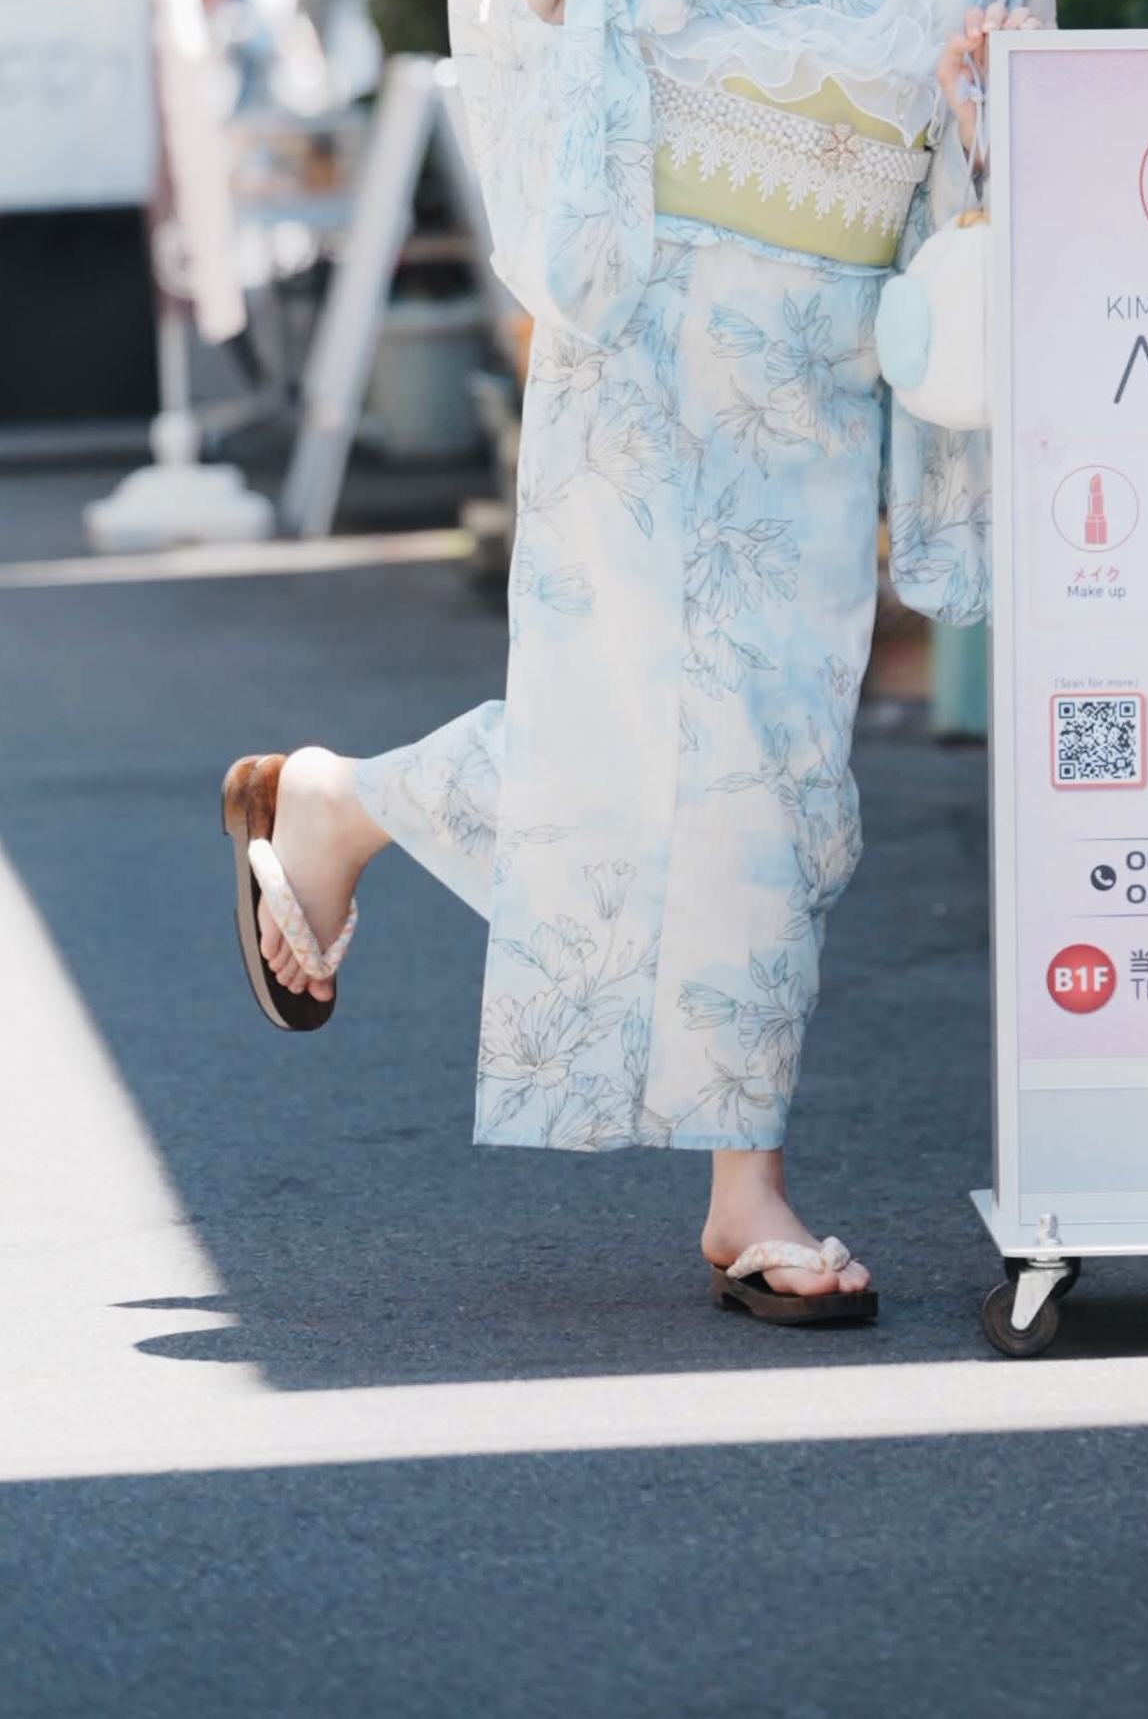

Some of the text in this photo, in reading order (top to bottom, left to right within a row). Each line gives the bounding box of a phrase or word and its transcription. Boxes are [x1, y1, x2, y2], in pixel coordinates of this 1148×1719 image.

[1073, 566, 1121, 583] メイク
[1067, 585, 1127, 600] Make up
[1053, 966, 1110, 994] B1F
